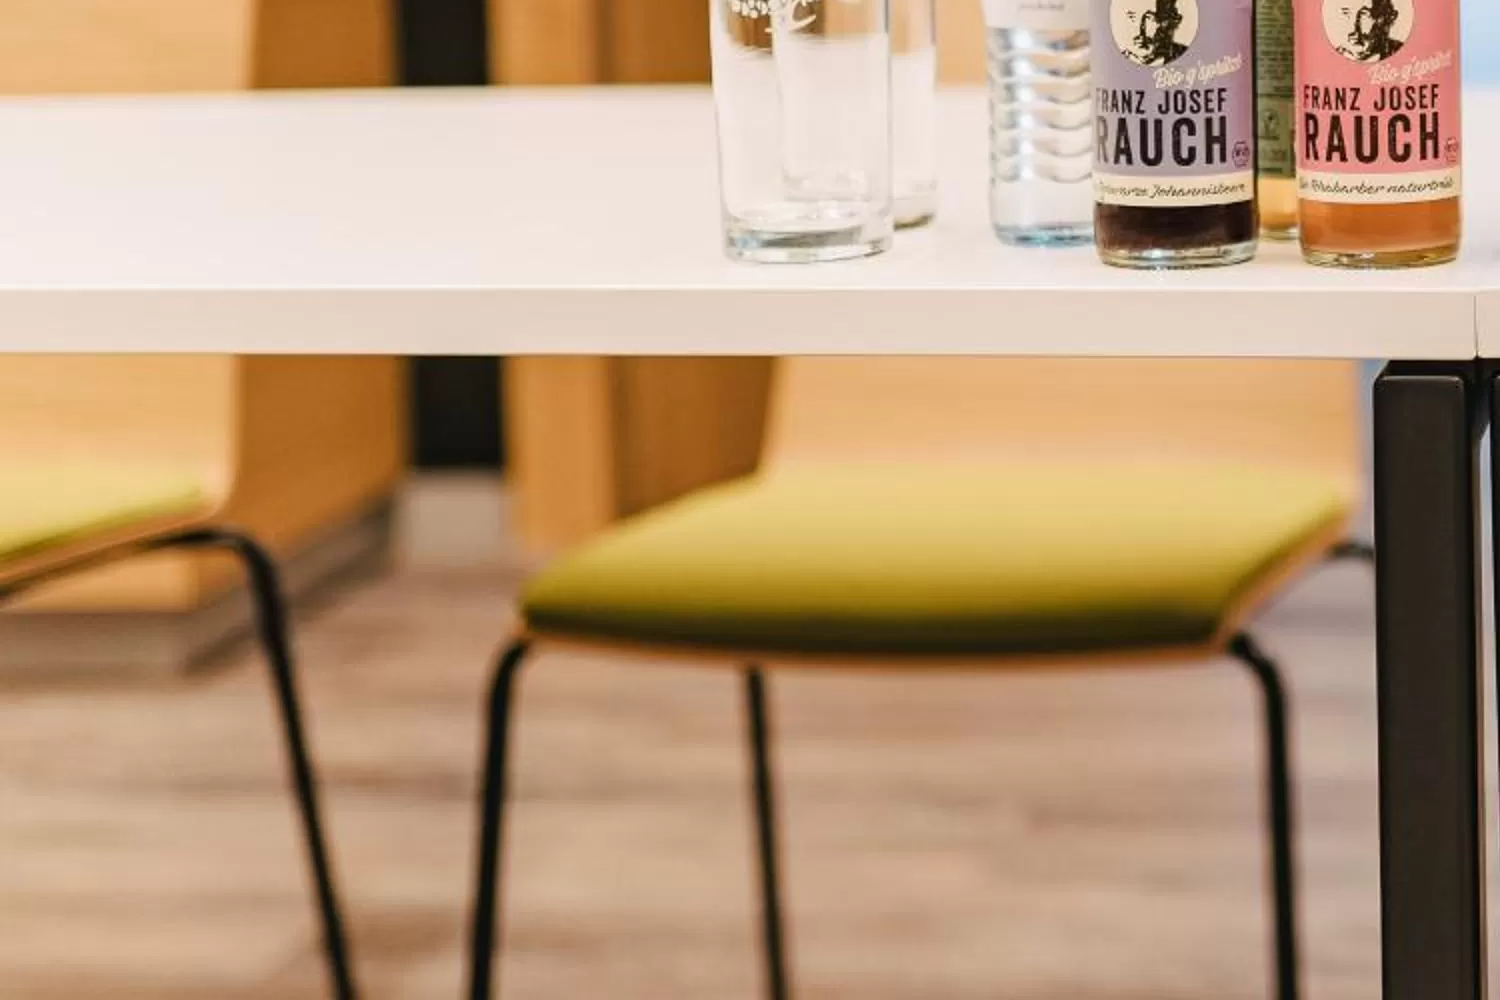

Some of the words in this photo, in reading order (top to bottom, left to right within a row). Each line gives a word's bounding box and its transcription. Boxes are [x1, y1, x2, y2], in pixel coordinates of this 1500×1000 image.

[1096, 88, 1146, 114] FRANZ
[1158, 88, 1228, 115] JOSEF
[1303, 86, 1360, 111] FRANZ
[1374, 84, 1440, 112] JOSEF
[1097, 115, 1228, 166] RAUCH
[1305, 112, 1440, 164] RAUCH
